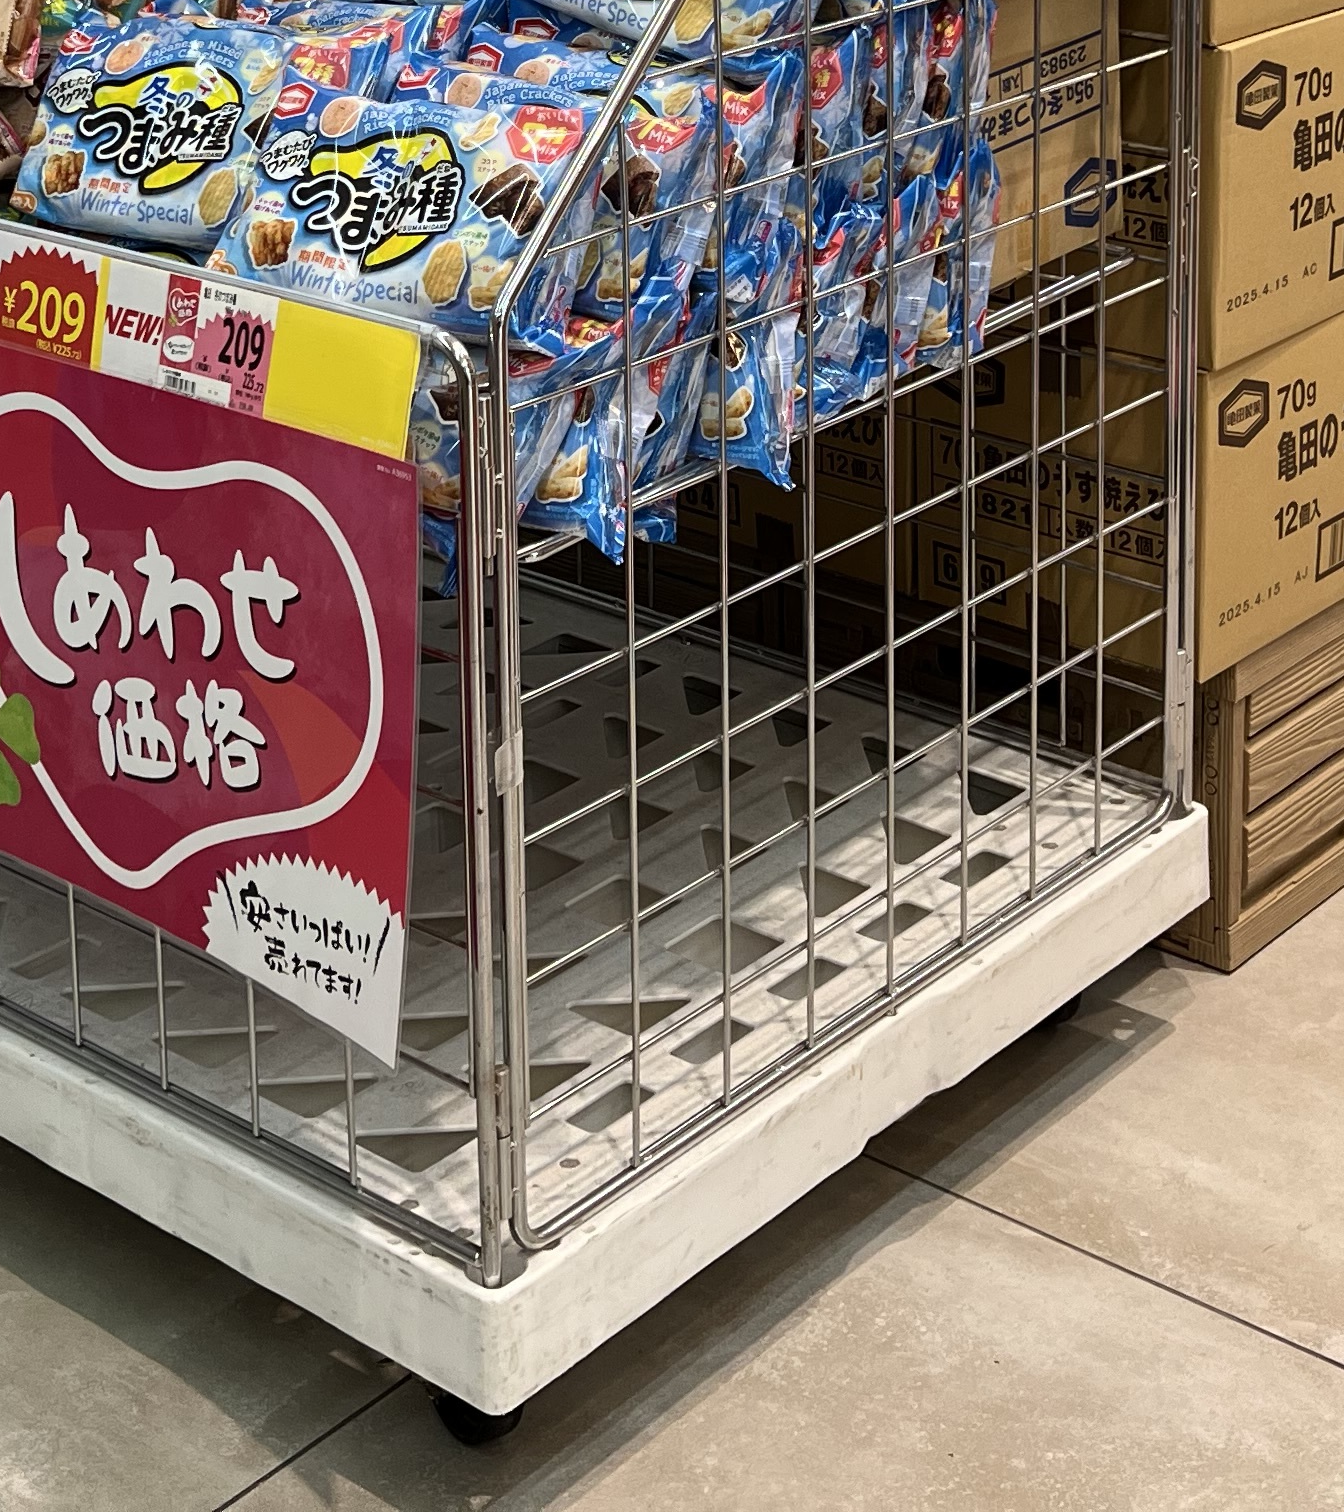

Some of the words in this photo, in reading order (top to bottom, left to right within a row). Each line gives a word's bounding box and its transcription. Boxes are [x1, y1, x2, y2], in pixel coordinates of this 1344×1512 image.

[1292, 68, 1334, 107] 70g
[80, 190, 135, 216] Winter
[137, 200, 195, 224] Special
[1289, 192, 1337, 232] 12個入
[291, 261, 359, 301] Winter
[355, 275, 419, 305] Special
[1226, 274, 1290, 313] 2025.4.15
[105, 304, 164, 346] NEW!
[218, 317, 265, 372] 209
[1275, 378, 1318, 421] 70g
[1274, 500, 1323, 540] 12個入
[1218, 582, 1282, 628] 2025.4.15
[93, 677, 268, 790] 価格
[262, 934, 364, 1008] 売れてます!
